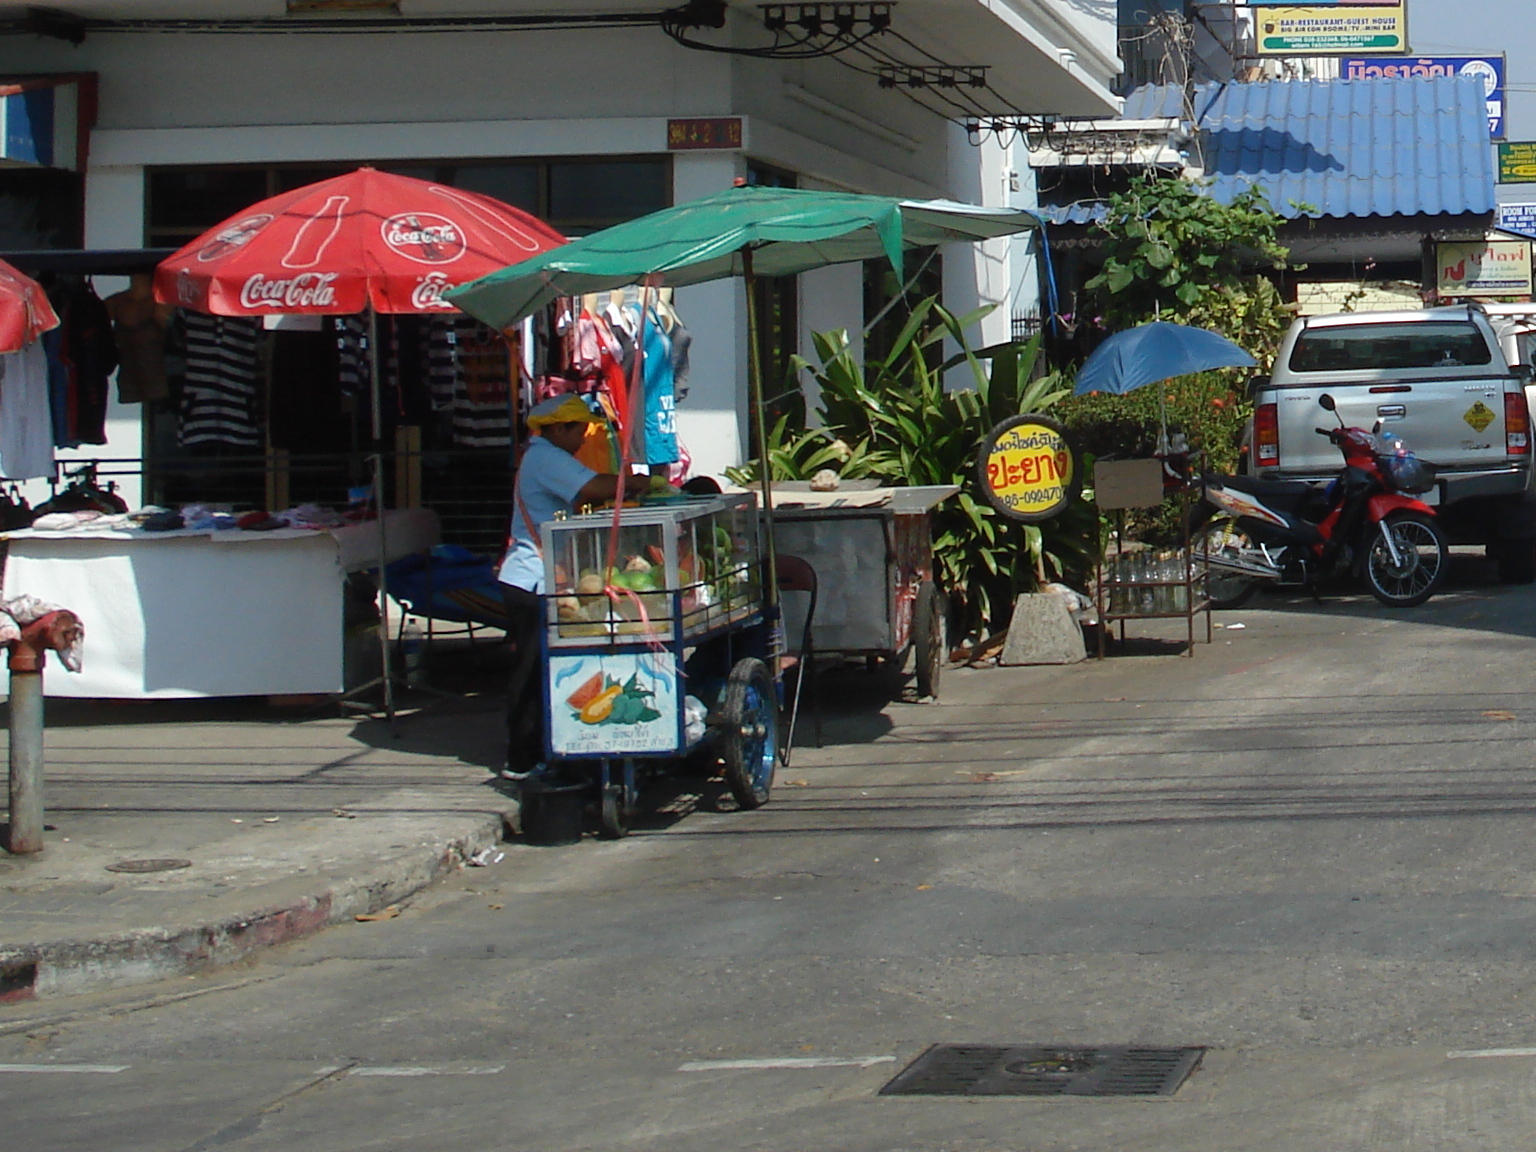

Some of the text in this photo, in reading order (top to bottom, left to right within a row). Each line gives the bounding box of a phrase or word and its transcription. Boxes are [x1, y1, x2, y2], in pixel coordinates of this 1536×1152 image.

[1372, 17, 1396, 25] HOUSE
[1502, 207, 1523, 216] ROOM
[387, 225, 456, 246] Coca-Cola
[240, 272, 336, 309] Coca-Cola
[986, 451, 1068, 490] ปะยาง
